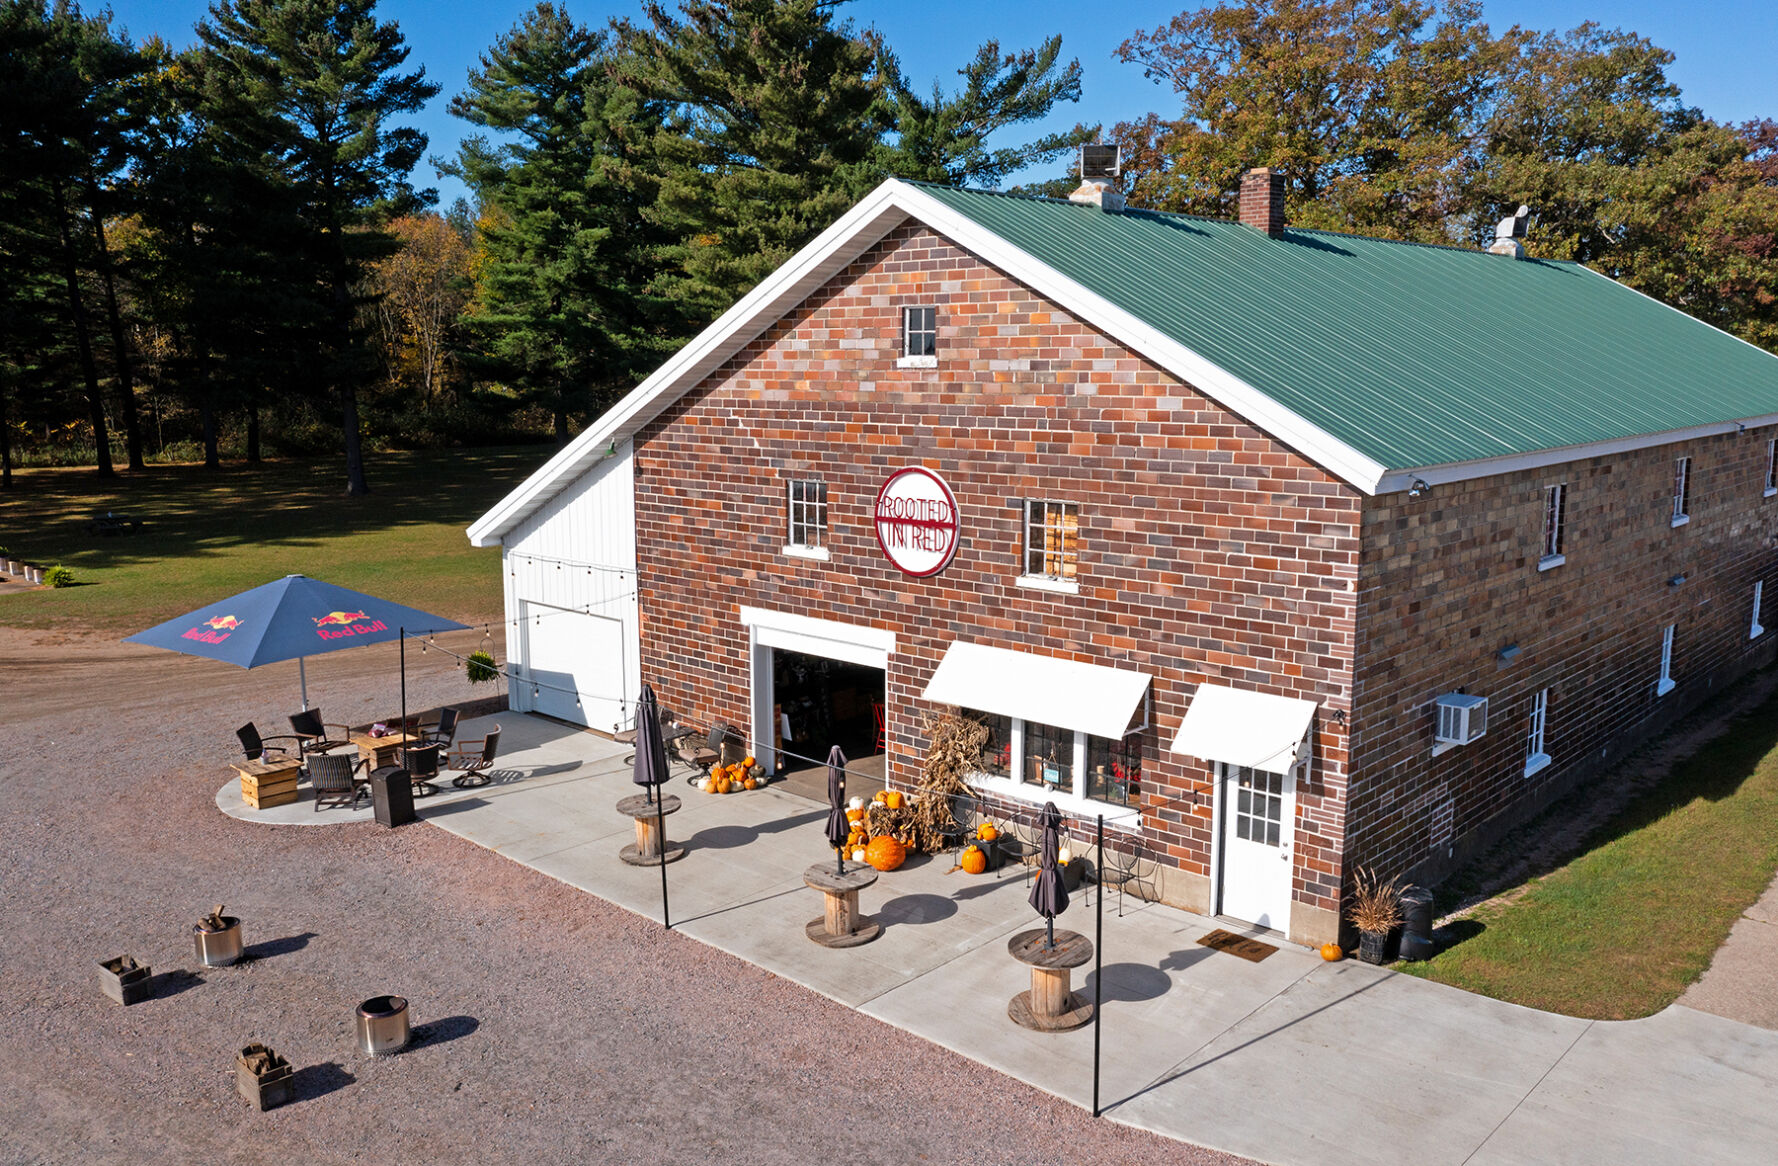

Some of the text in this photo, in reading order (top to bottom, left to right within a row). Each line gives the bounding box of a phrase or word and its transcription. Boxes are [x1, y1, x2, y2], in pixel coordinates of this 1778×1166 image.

[884, 495, 948, 523] ROOTED
[888, 520, 946, 552] IN RED
[180, 627, 231, 645] Red Bull
[316, 620, 388, 640] Red Bull
